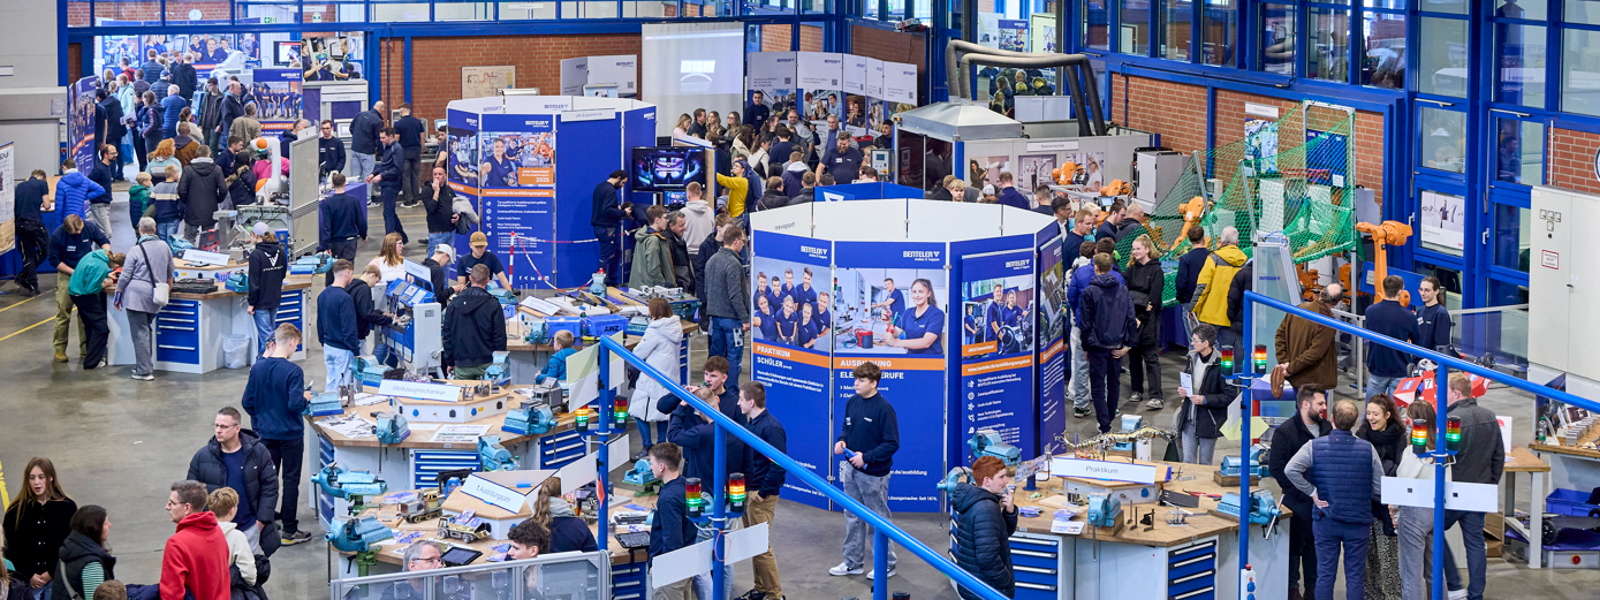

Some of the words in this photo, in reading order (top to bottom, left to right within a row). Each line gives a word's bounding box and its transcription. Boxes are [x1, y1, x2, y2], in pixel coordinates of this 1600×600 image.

[801, 245, 824, 254] BENTELER
[1005, 260, 1026, 268] BENTELER
[757, 345, 790, 358] PRAKTIKUM
[757, 357, 782, 367] SCHÜLER
[392, 385, 446, 396] Werkzeugmechaniker
[1085, 465, 1118, 474] Praktikum
